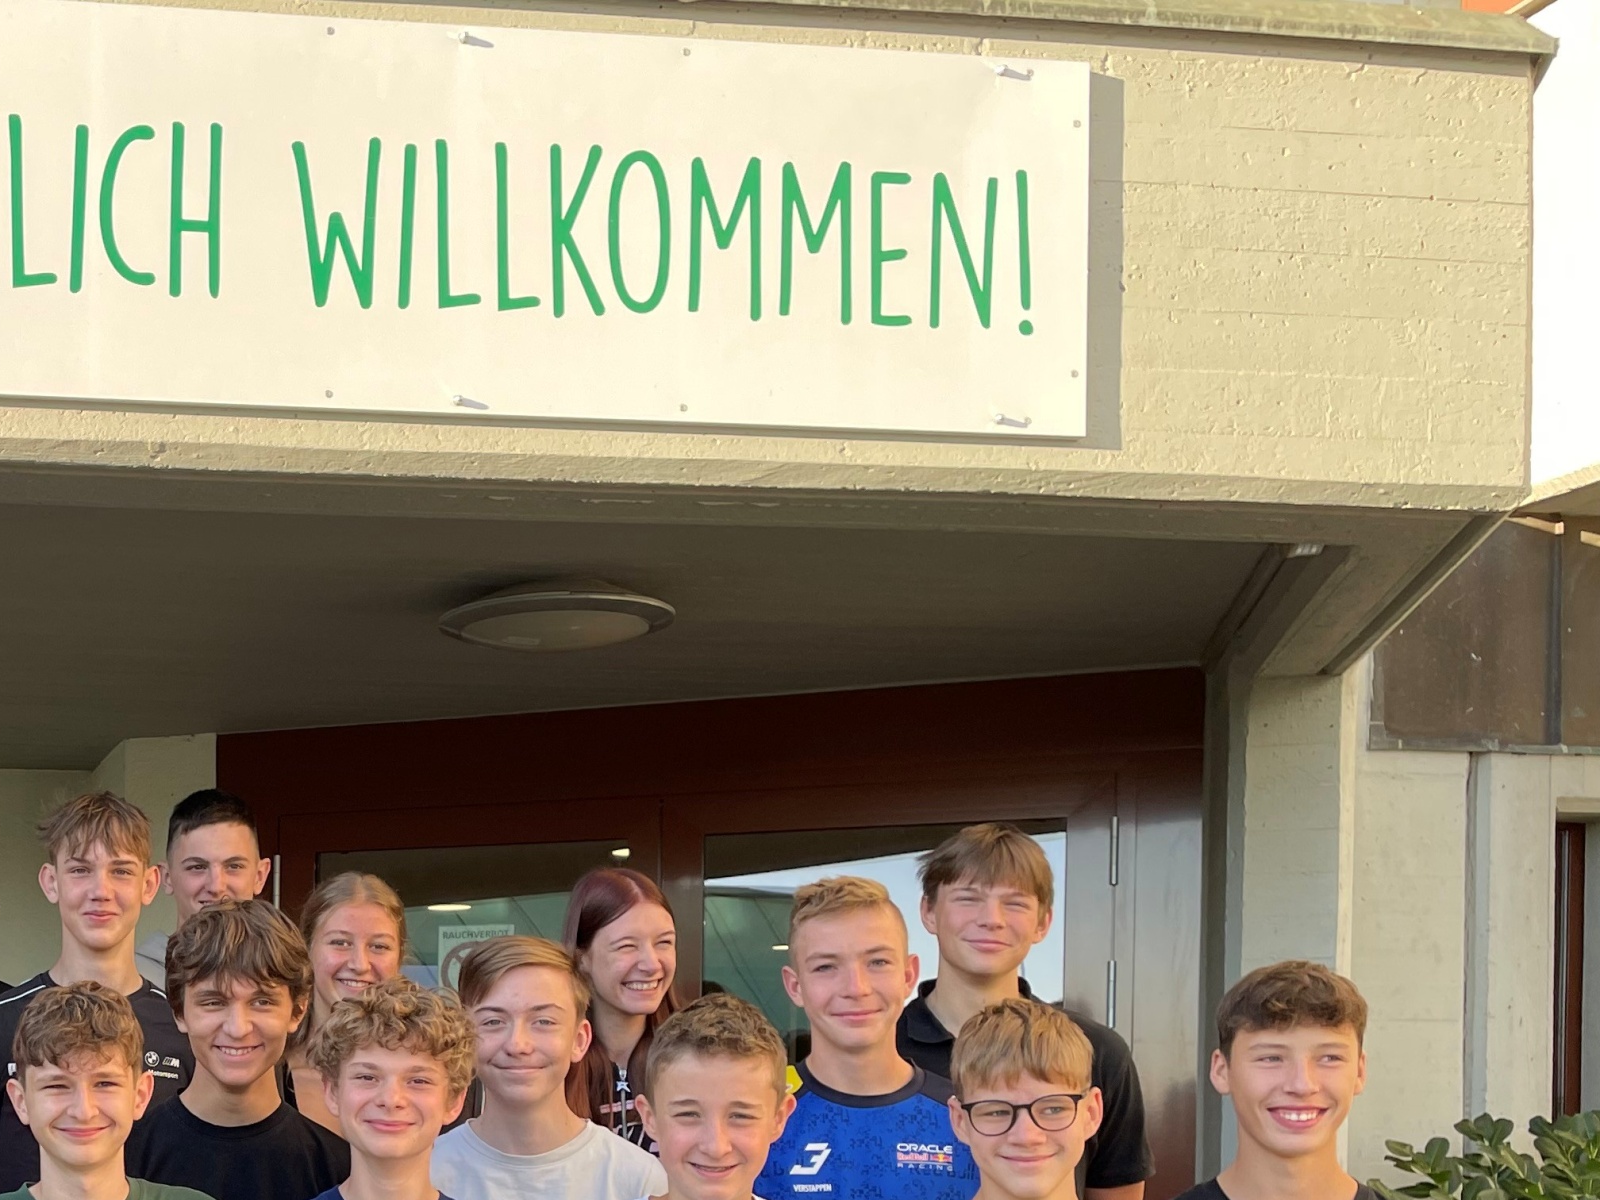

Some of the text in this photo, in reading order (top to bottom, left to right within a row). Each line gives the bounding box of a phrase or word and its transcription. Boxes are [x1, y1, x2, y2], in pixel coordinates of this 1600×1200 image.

[292, 137, 1034, 335] WILLKOMMEN!
[897, 1143, 953, 1154] ORACLE
[897, 1163, 953, 1171] RACING
